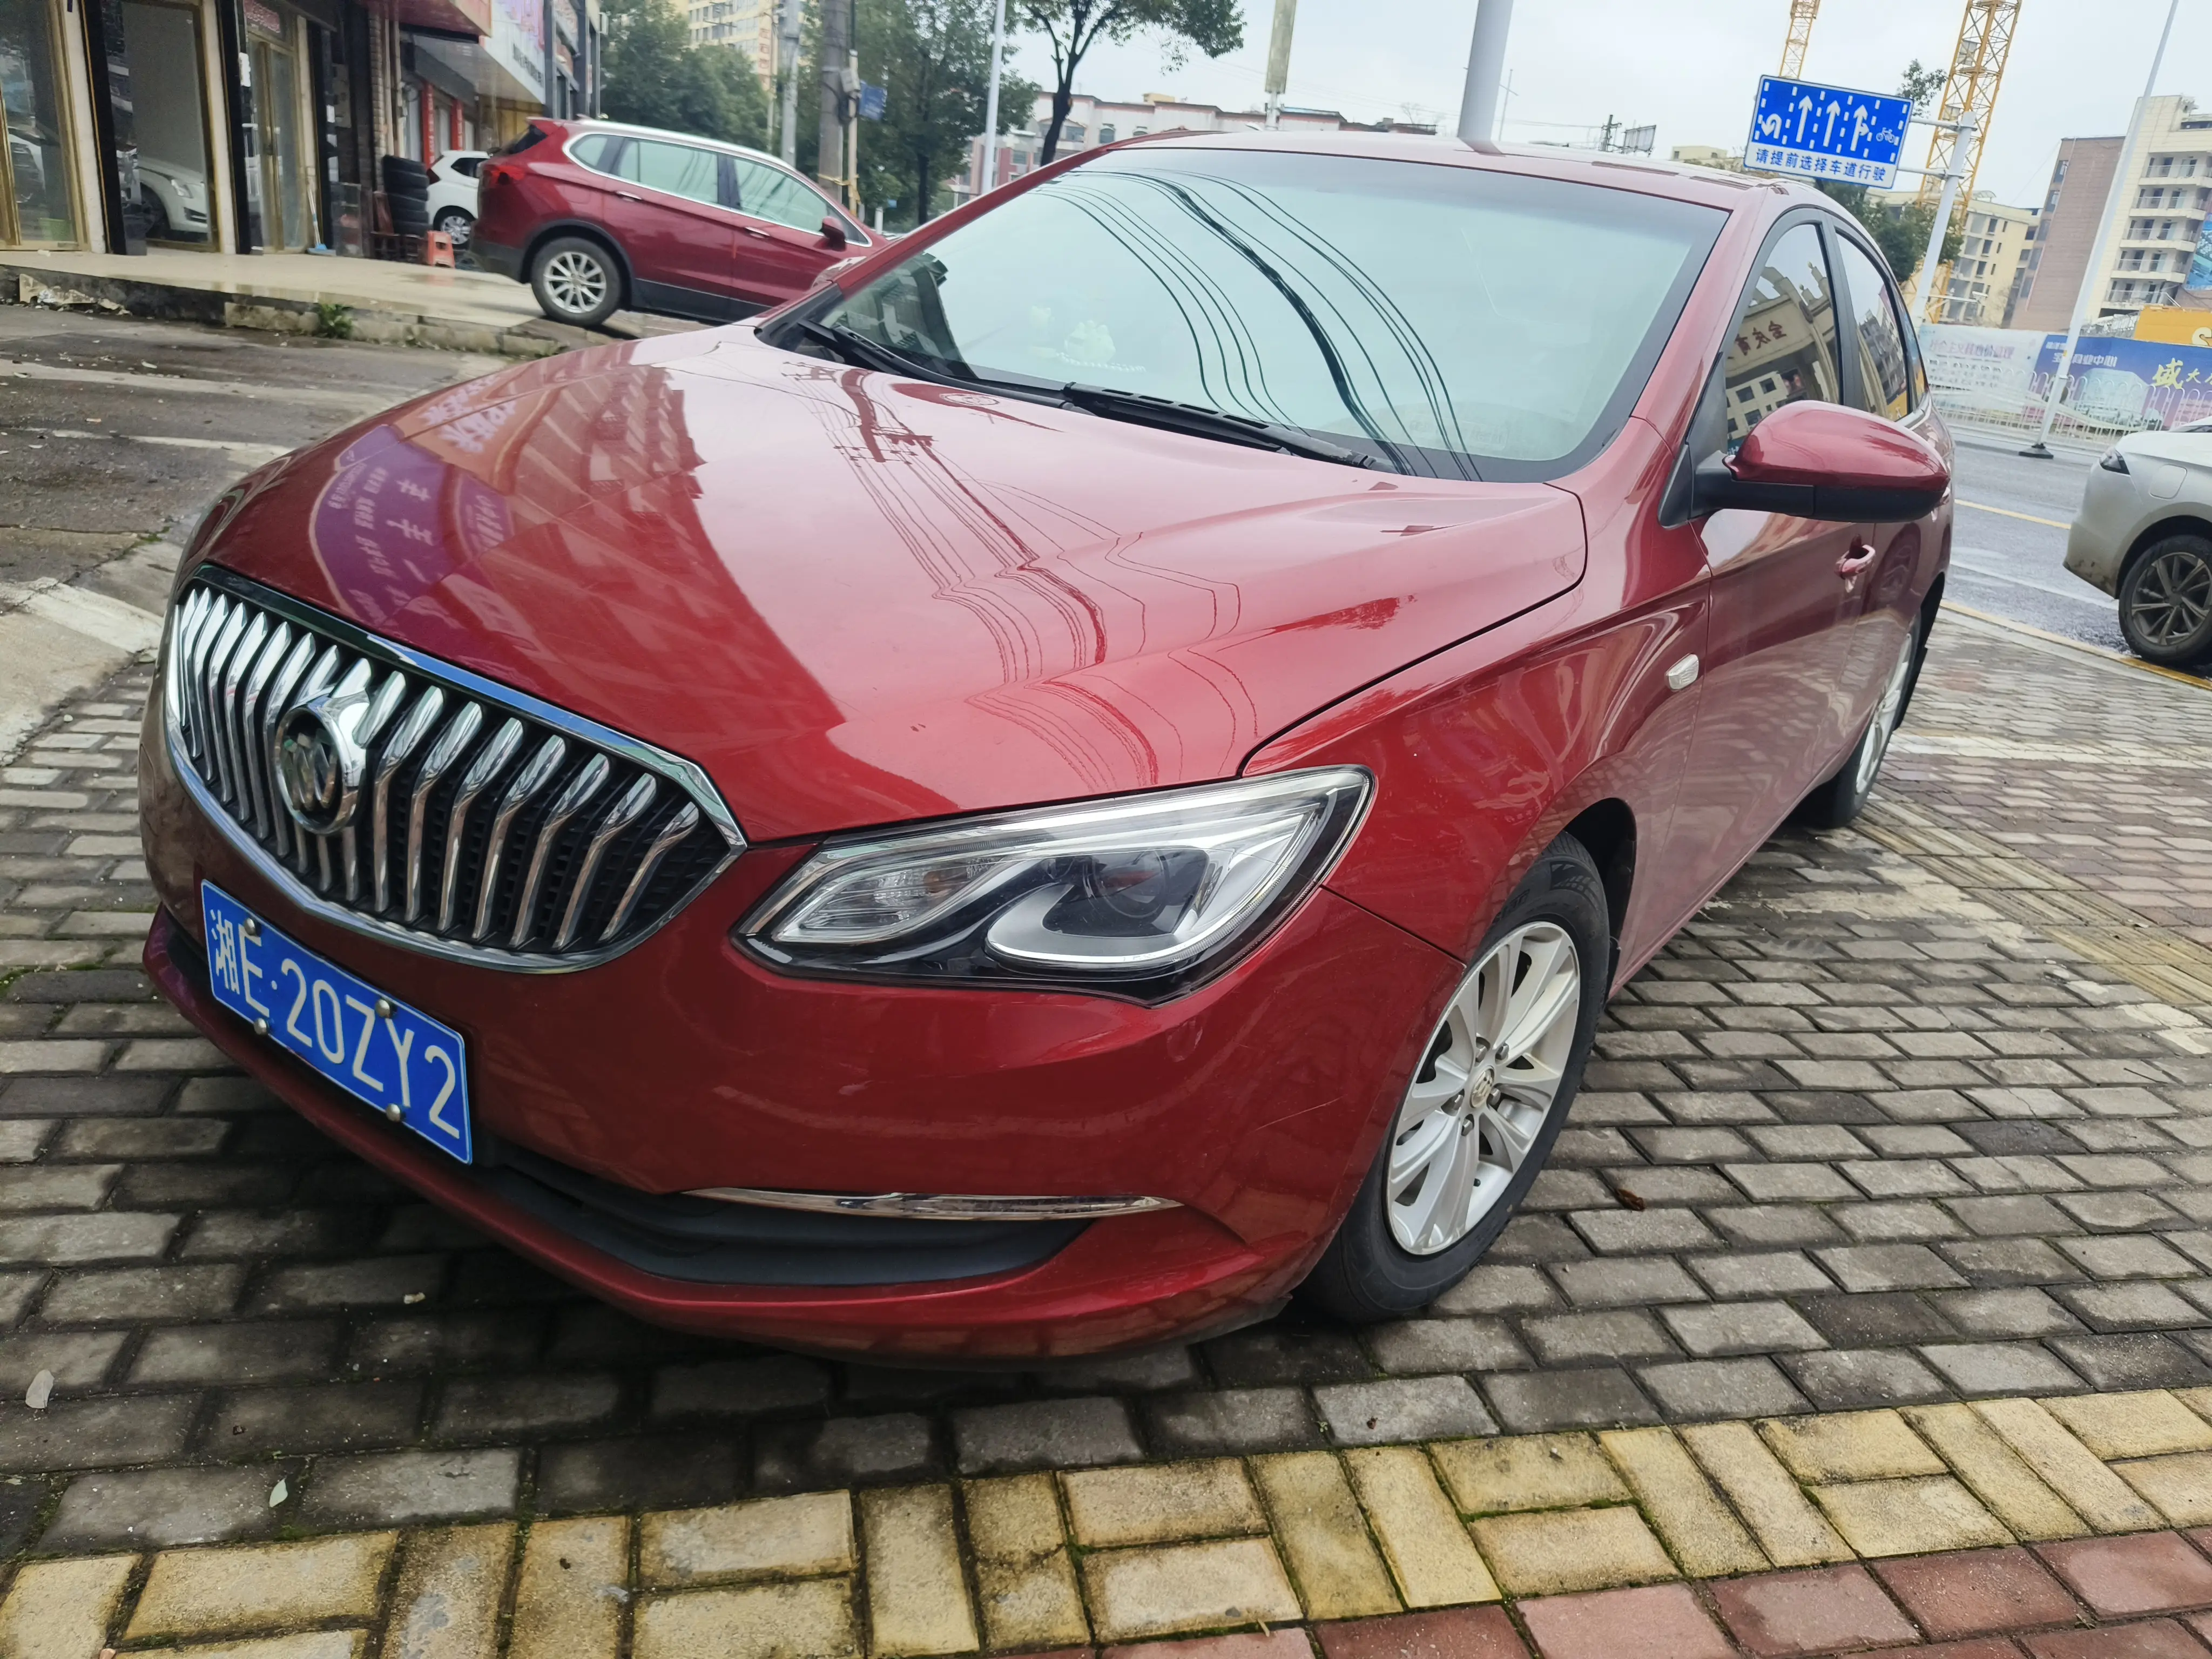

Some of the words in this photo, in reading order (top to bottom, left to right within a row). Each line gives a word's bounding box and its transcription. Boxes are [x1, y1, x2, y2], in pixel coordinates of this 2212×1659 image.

[1756, 147, 1887, 181] 请提前选择车道行驶
[2052, 352, 2118, 368] 宝商业中心
